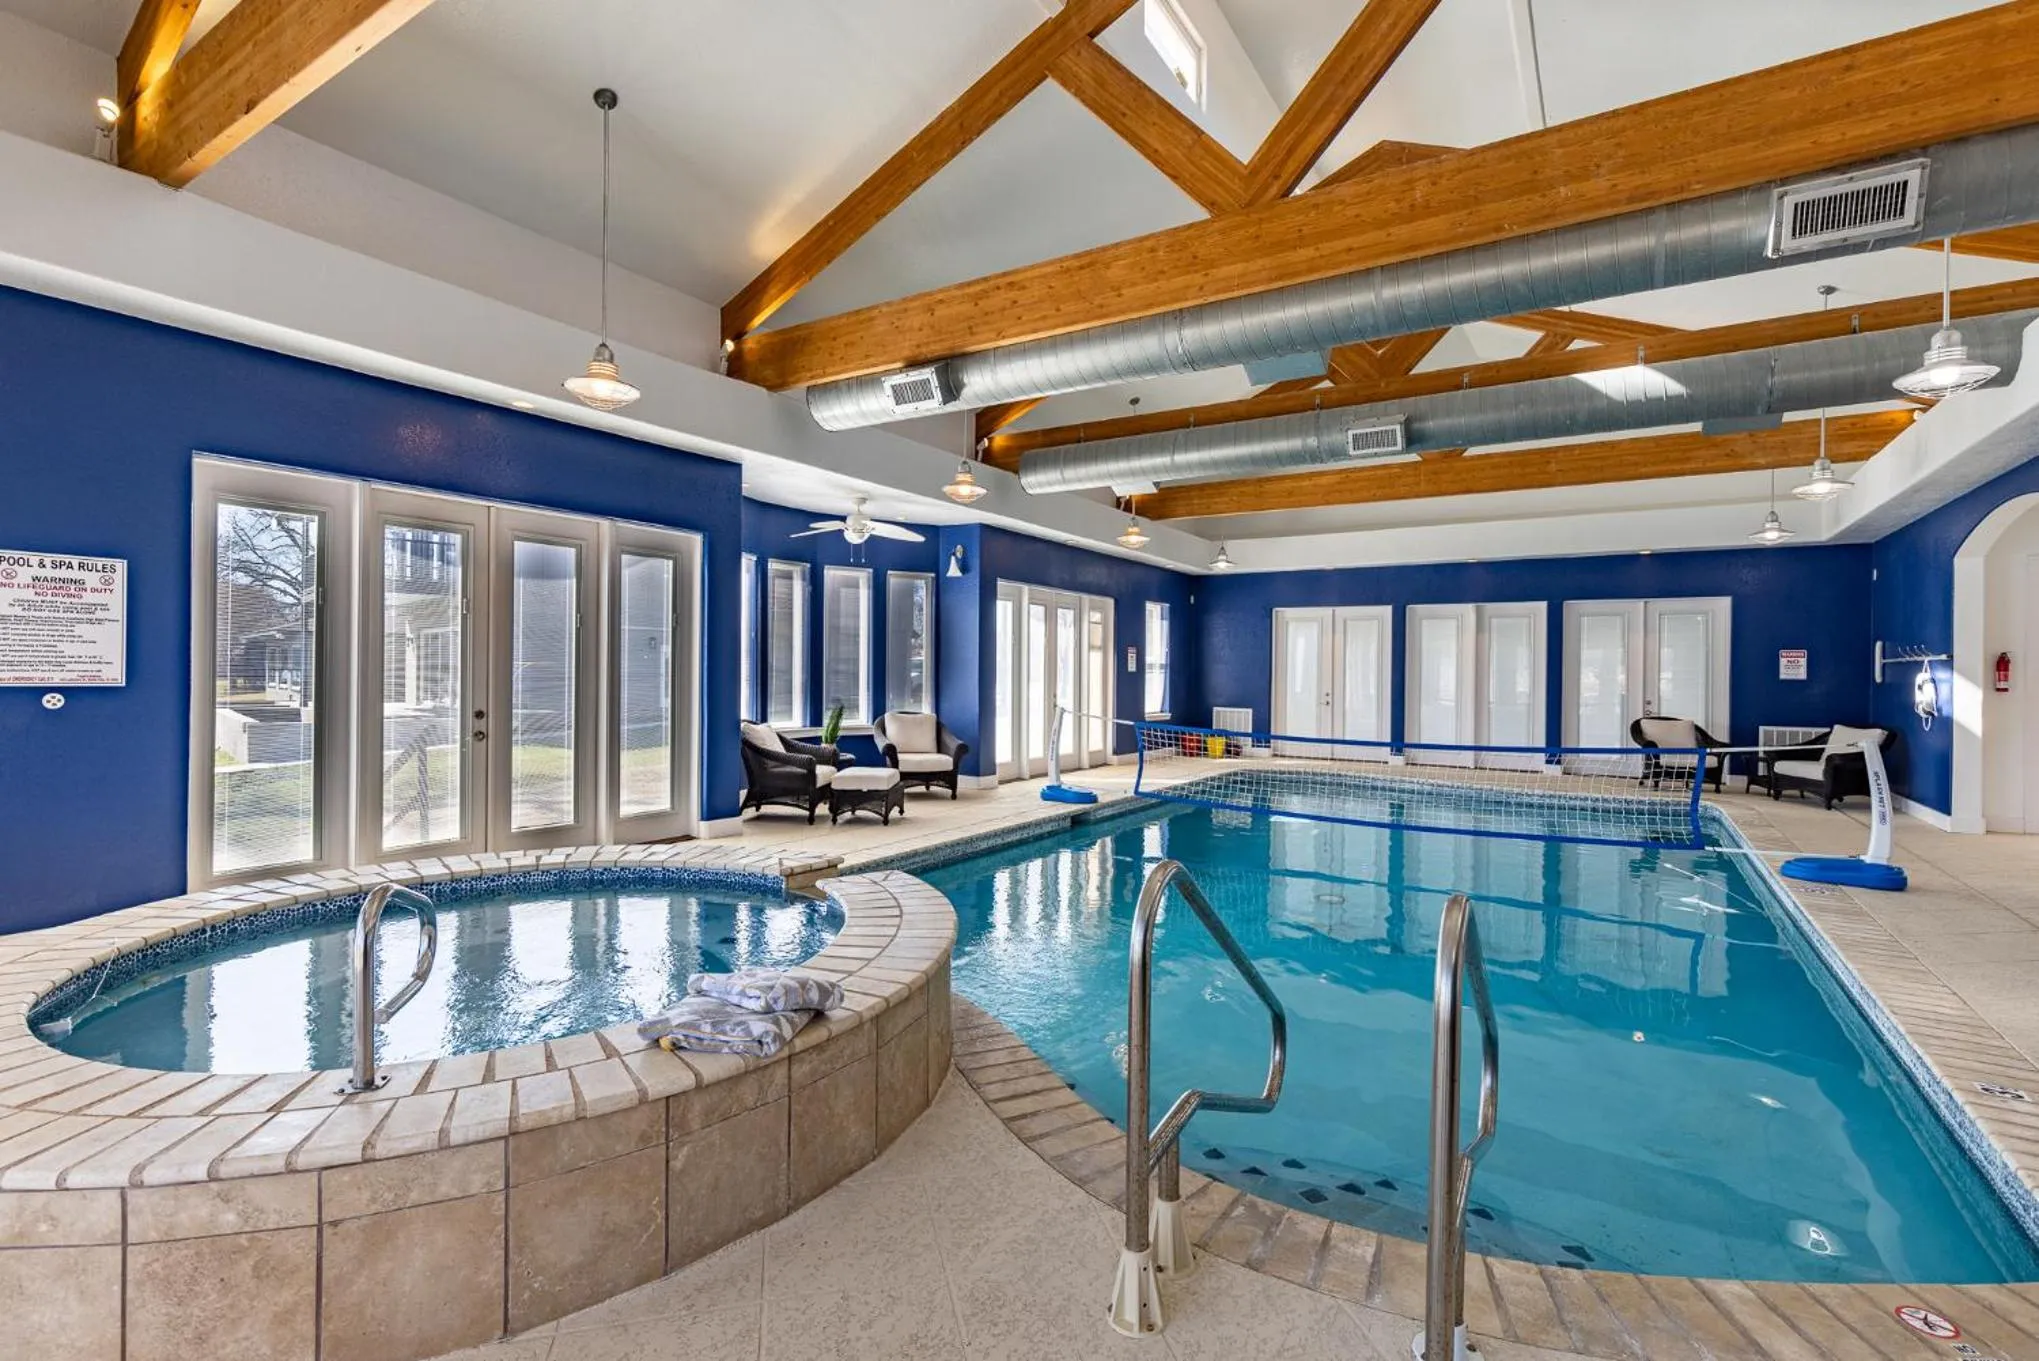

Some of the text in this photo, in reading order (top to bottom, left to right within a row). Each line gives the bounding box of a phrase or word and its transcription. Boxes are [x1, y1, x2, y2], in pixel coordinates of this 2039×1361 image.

[0, 556, 117, 574] POOL & SPA RULES
[31, 575, 86, 586] WARNING
[17, 582, 71, 592] LIFEGUARD
